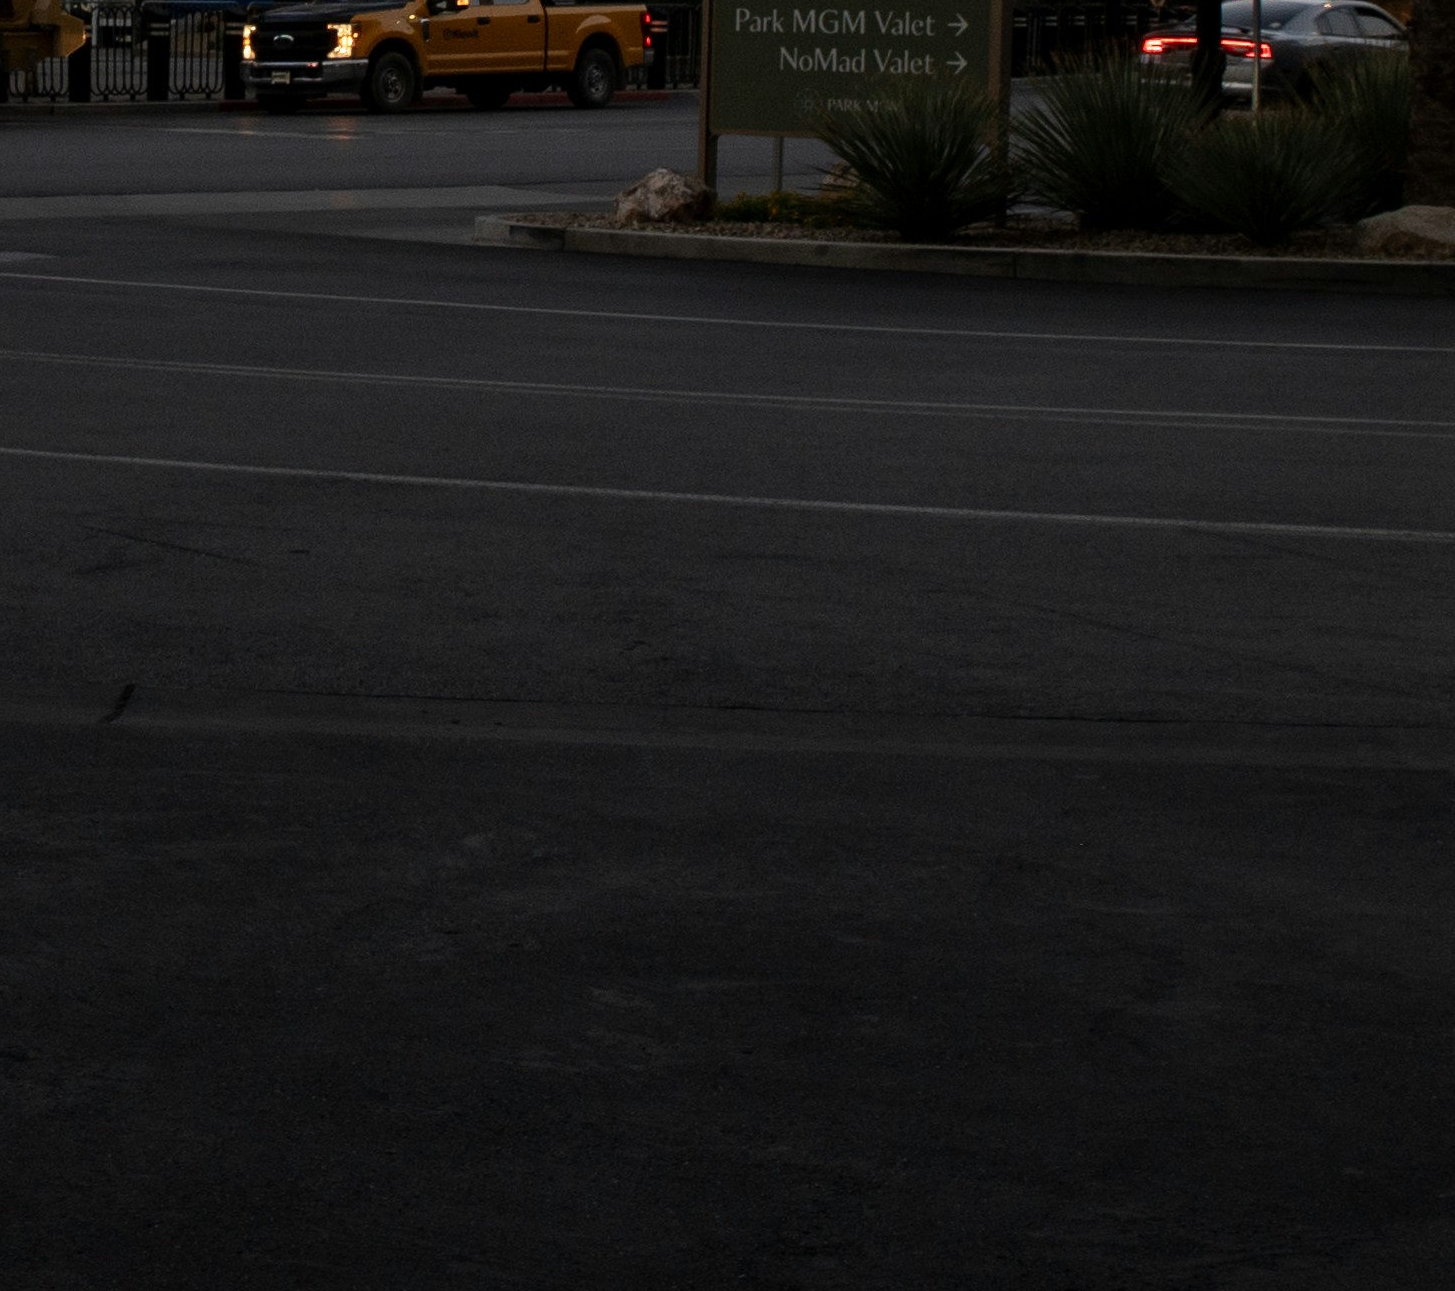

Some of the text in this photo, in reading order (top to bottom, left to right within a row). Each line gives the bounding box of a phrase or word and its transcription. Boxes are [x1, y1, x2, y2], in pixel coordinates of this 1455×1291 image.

[735, 7, 935, 37] Park MGM Valet
[780, 46, 934, 75] NoMad Valet
[827, 98, 862, 112] PARK
